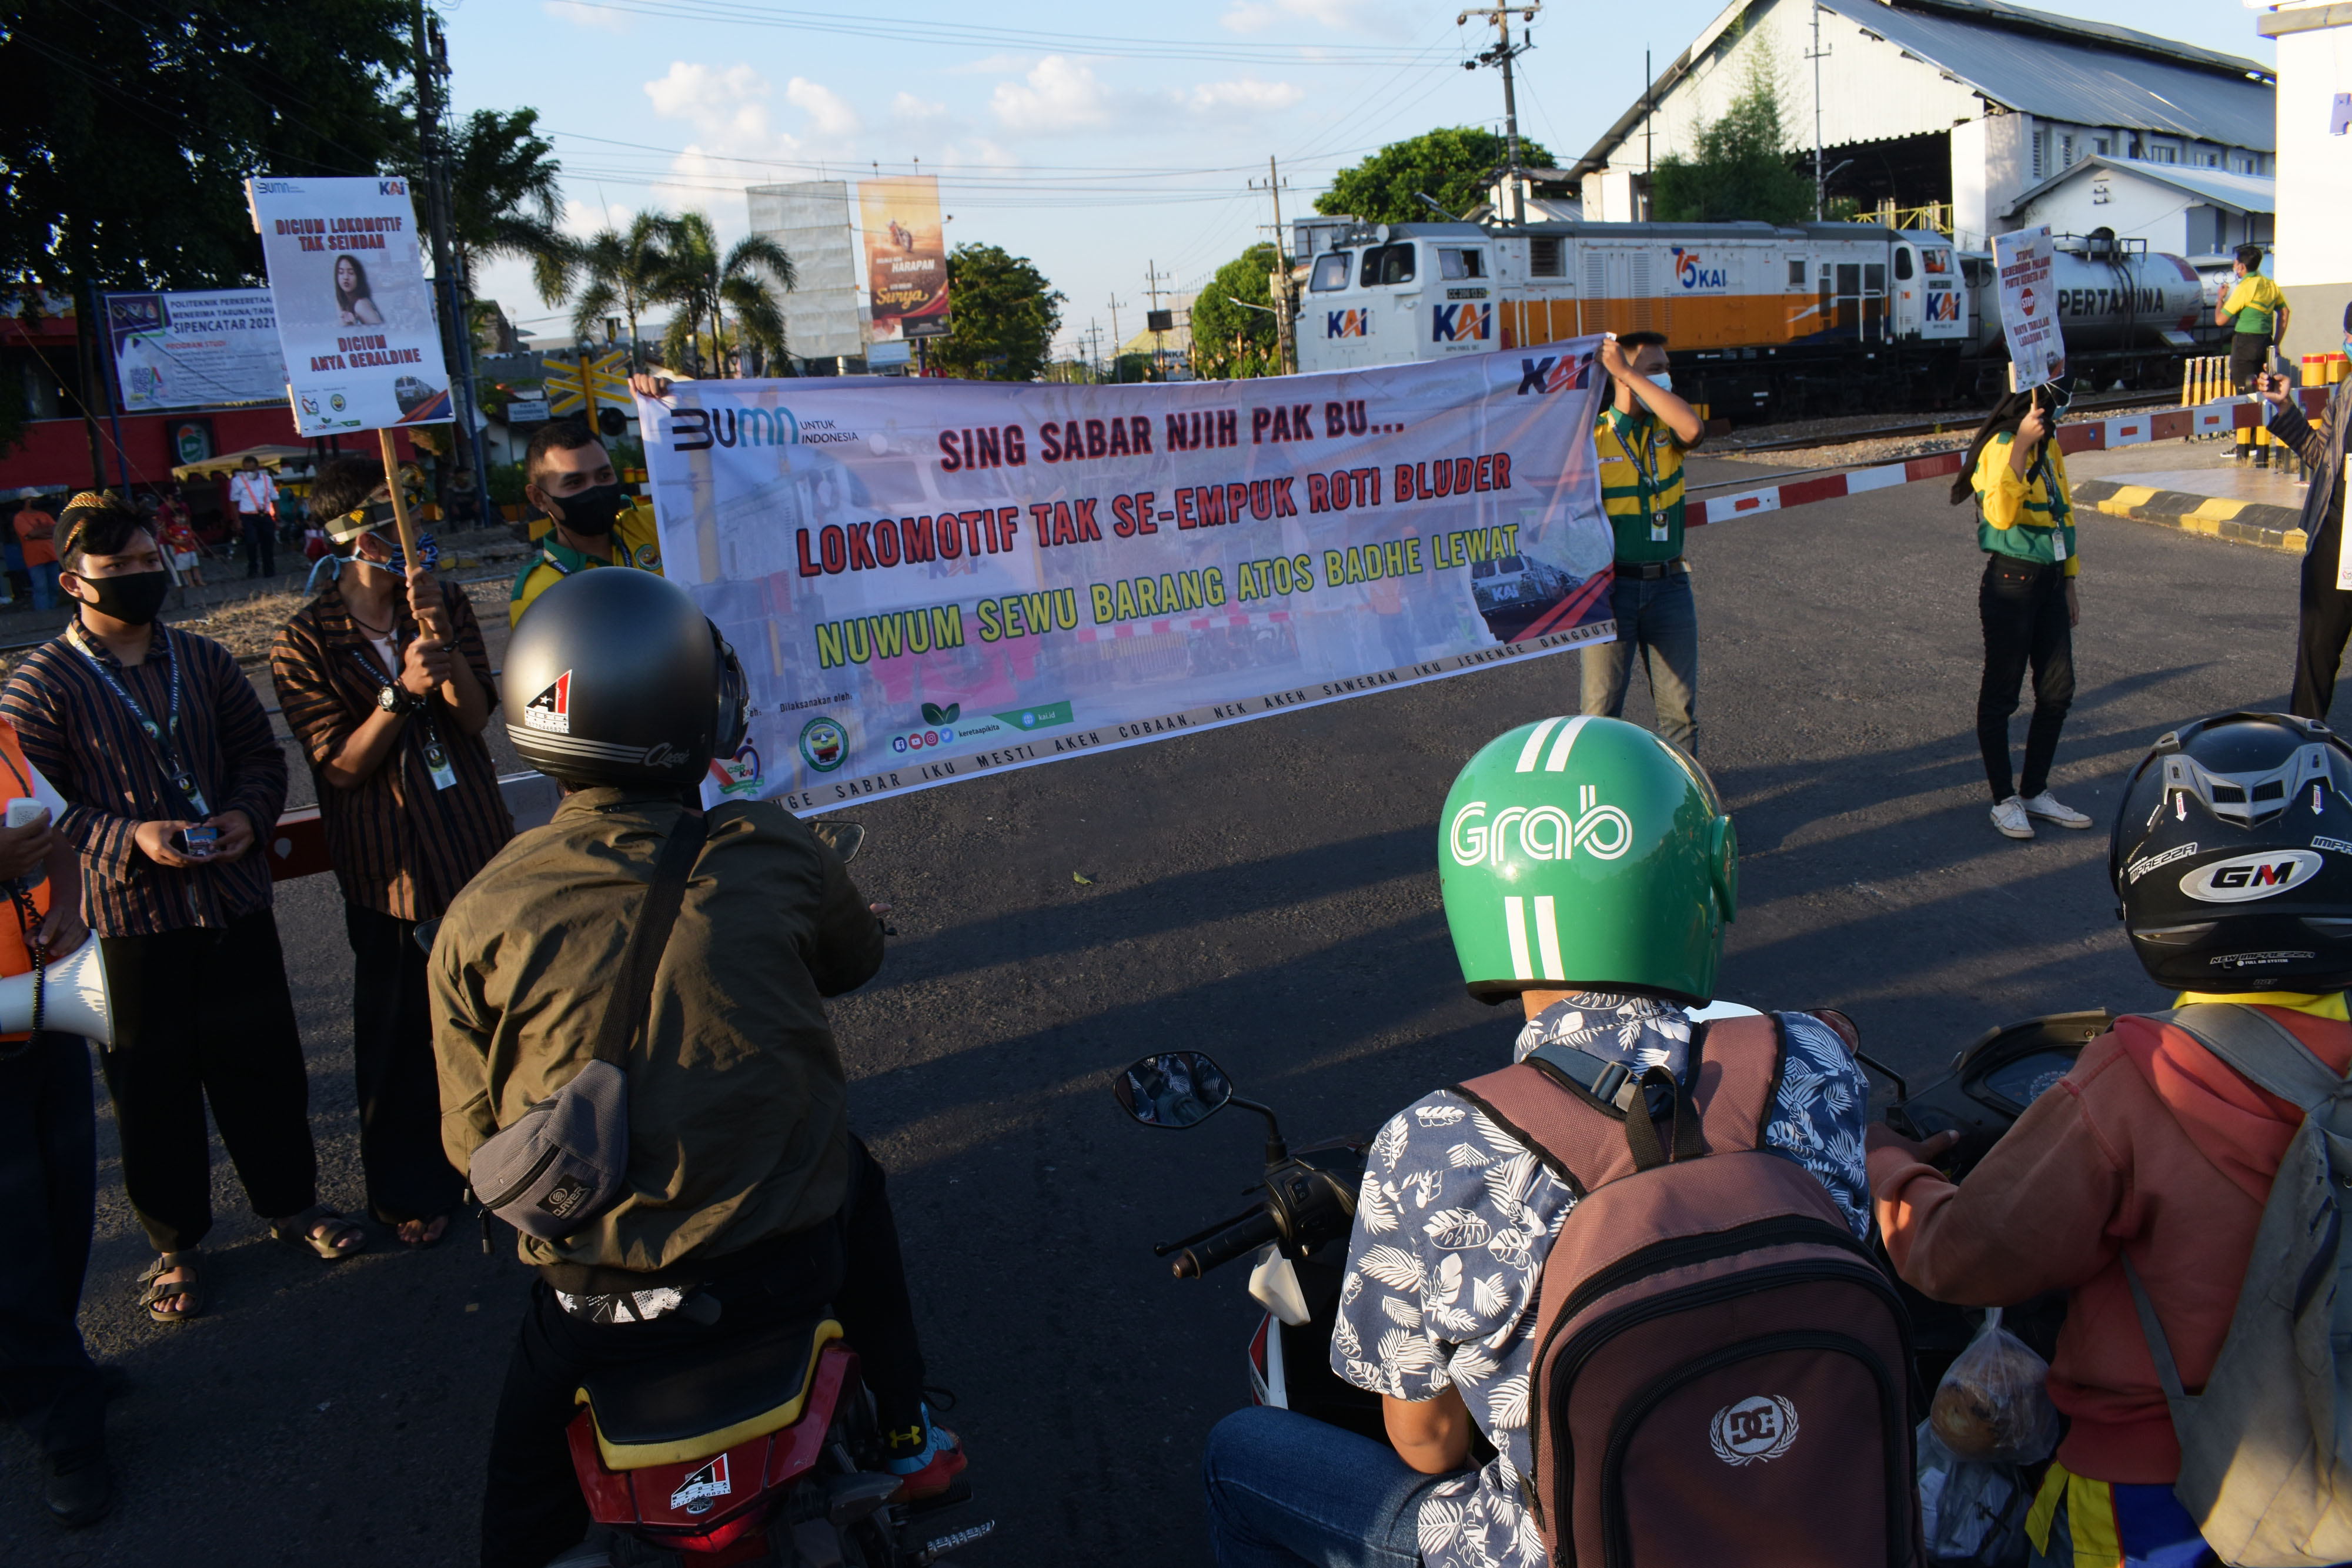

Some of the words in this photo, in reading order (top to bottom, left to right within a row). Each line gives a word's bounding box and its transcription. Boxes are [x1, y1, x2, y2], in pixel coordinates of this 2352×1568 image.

[379, 181, 405, 196] KAI
[275, 218, 326, 235] DICIUM
[329, 216, 402, 233] LOKOMOTIF
[298, 236, 325, 252] TAK
[328, 234, 385, 250] SEINDAH
[892, 259, 935, 273] HARAPAN
[1699, 269, 1726, 288] KAI
[170, 299, 218, 309] POLITEKNIK
[220, 296, 273, 306] PERKERETAA
[876, 287, 929, 310] Surya
[1926, 292, 1961, 322] KAI
[2021, 295, 2035, 309] STOP
[172, 310, 215, 319] MENERIMA
[1327, 307, 1368, 339] KAI
[1432, 302, 1492, 342] KAI
[173, 319, 247, 334] SIPENCATAR
[250, 317, 276, 329] 2021
[338, 335, 387, 353] DICIUM
[310, 355, 346, 372] ANYA
[348, 348, 422, 368] GERALDINE
[1517, 353, 1594, 396] KAI
[800, 419, 836, 431] UNTUK
[801, 430, 859, 445] INDONESIA
[939, 423, 1027, 473] SING
[1040, 414, 1152, 464] SABAR
[1166, 409, 1238, 453] NJIH
[1252, 403, 1314, 445] PAK
[1325, 399, 1405, 439] BU...
[796, 504, 1020, 578] LOKOMOTIF
[1029, 497, 1102, 549] TAK
[1111, 476, 1297, 539] SE-EMPUK
[1307, 466, 1381, 514] ROTI
[1394, 452, 1512, 503] BLUDER
[814, 602, 964, 670] NUWUM
[977, 586, 1078, 643] SEWU
[1089, 566, 1227, 624] BARANG
[1237, 553, 1315, 603] ATOS
[1324, 538, 1423, 589] BADHE
[1432, 523, 1520, 570] LEWAT
[1491, 583, 1520, 602] KAI
[779, 697, 831, 713] Dilaksanakan
[833, 693, 853, 704] oleh:
[835, 773, 901, 798] SABAR
[922, 761, 956, 780] IKU
[975, 744, 1035, 768] MESTI
[1054, 731, 1100, 753] AKEH
[1118, 715, 1197, 738] COBAAN,
[1214, 702, 1248, 721] NEK
[1264, 688, 1307, 708] AKEH
[1322, 671, 1398, 697] SAWERAN
[1414, 659, 1442, 676] IKU
[1457, 643, 1525, 669] JENENGE
[1038, 712, 1055, 722] kai.id
[958, 724, 1000, 738] keretaapikita
[644, 741, 691, 768] Classic
[727, 764, 746, 774] CSR
[739, 768, 754, 778] KAI
[1450, 785, 1633, 867] Grab
[2130, 842, 2197, 884] IMPREZZA
[2210, 860, 2297, 888] GM
[2210, 954, 2239, 965] NEW
[2239, 951, 2316, 961] IMPREZZA
[1730, 1405, 1776, 1445] DC
